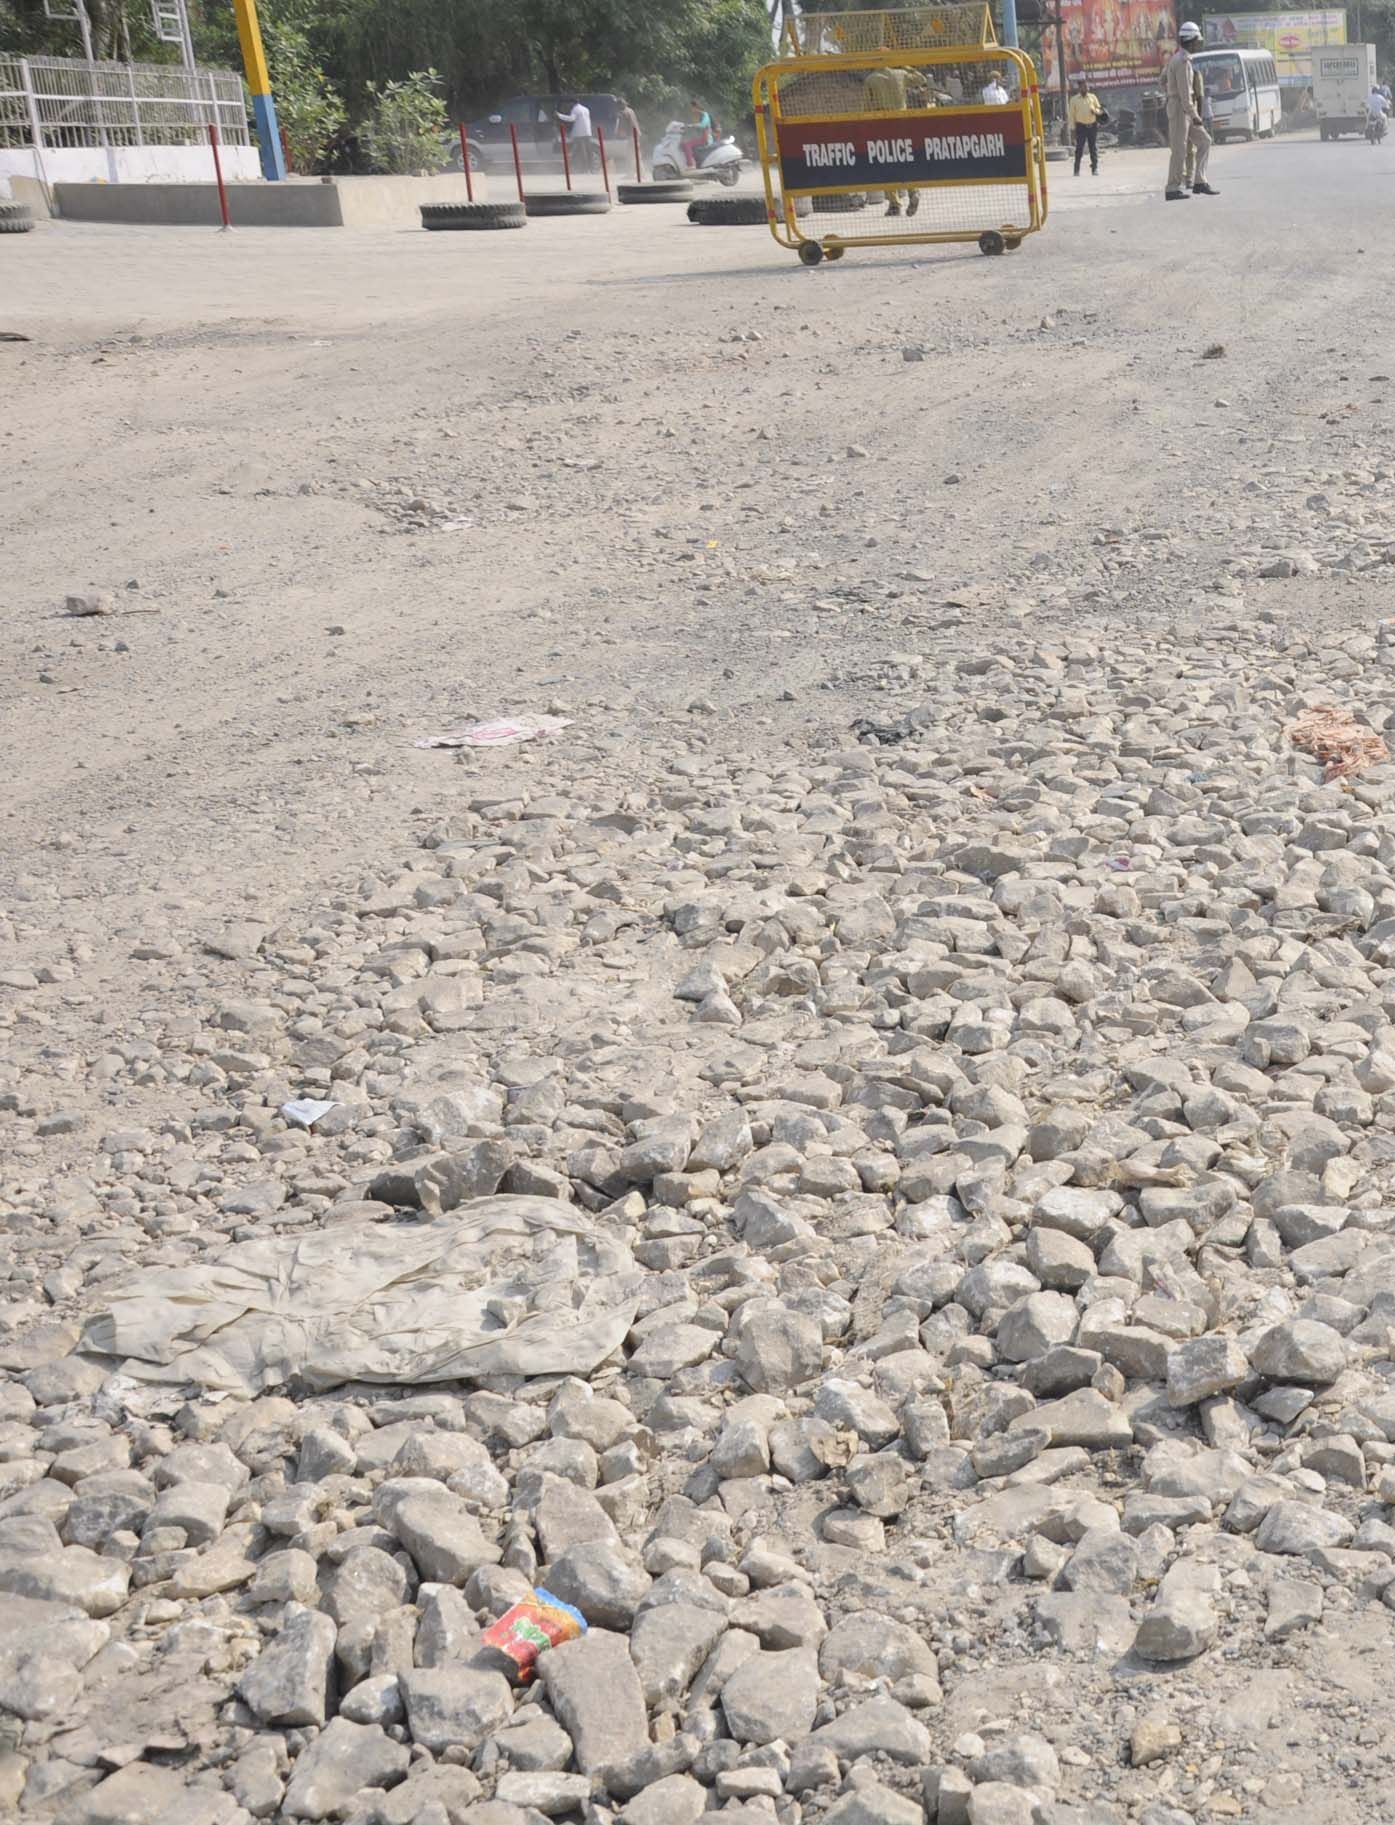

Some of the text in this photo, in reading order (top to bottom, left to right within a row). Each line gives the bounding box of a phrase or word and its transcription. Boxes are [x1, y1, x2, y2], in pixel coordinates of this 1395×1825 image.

[802, 133, 1005, 167] TRAFFIC POLICE PRATAPGARH
